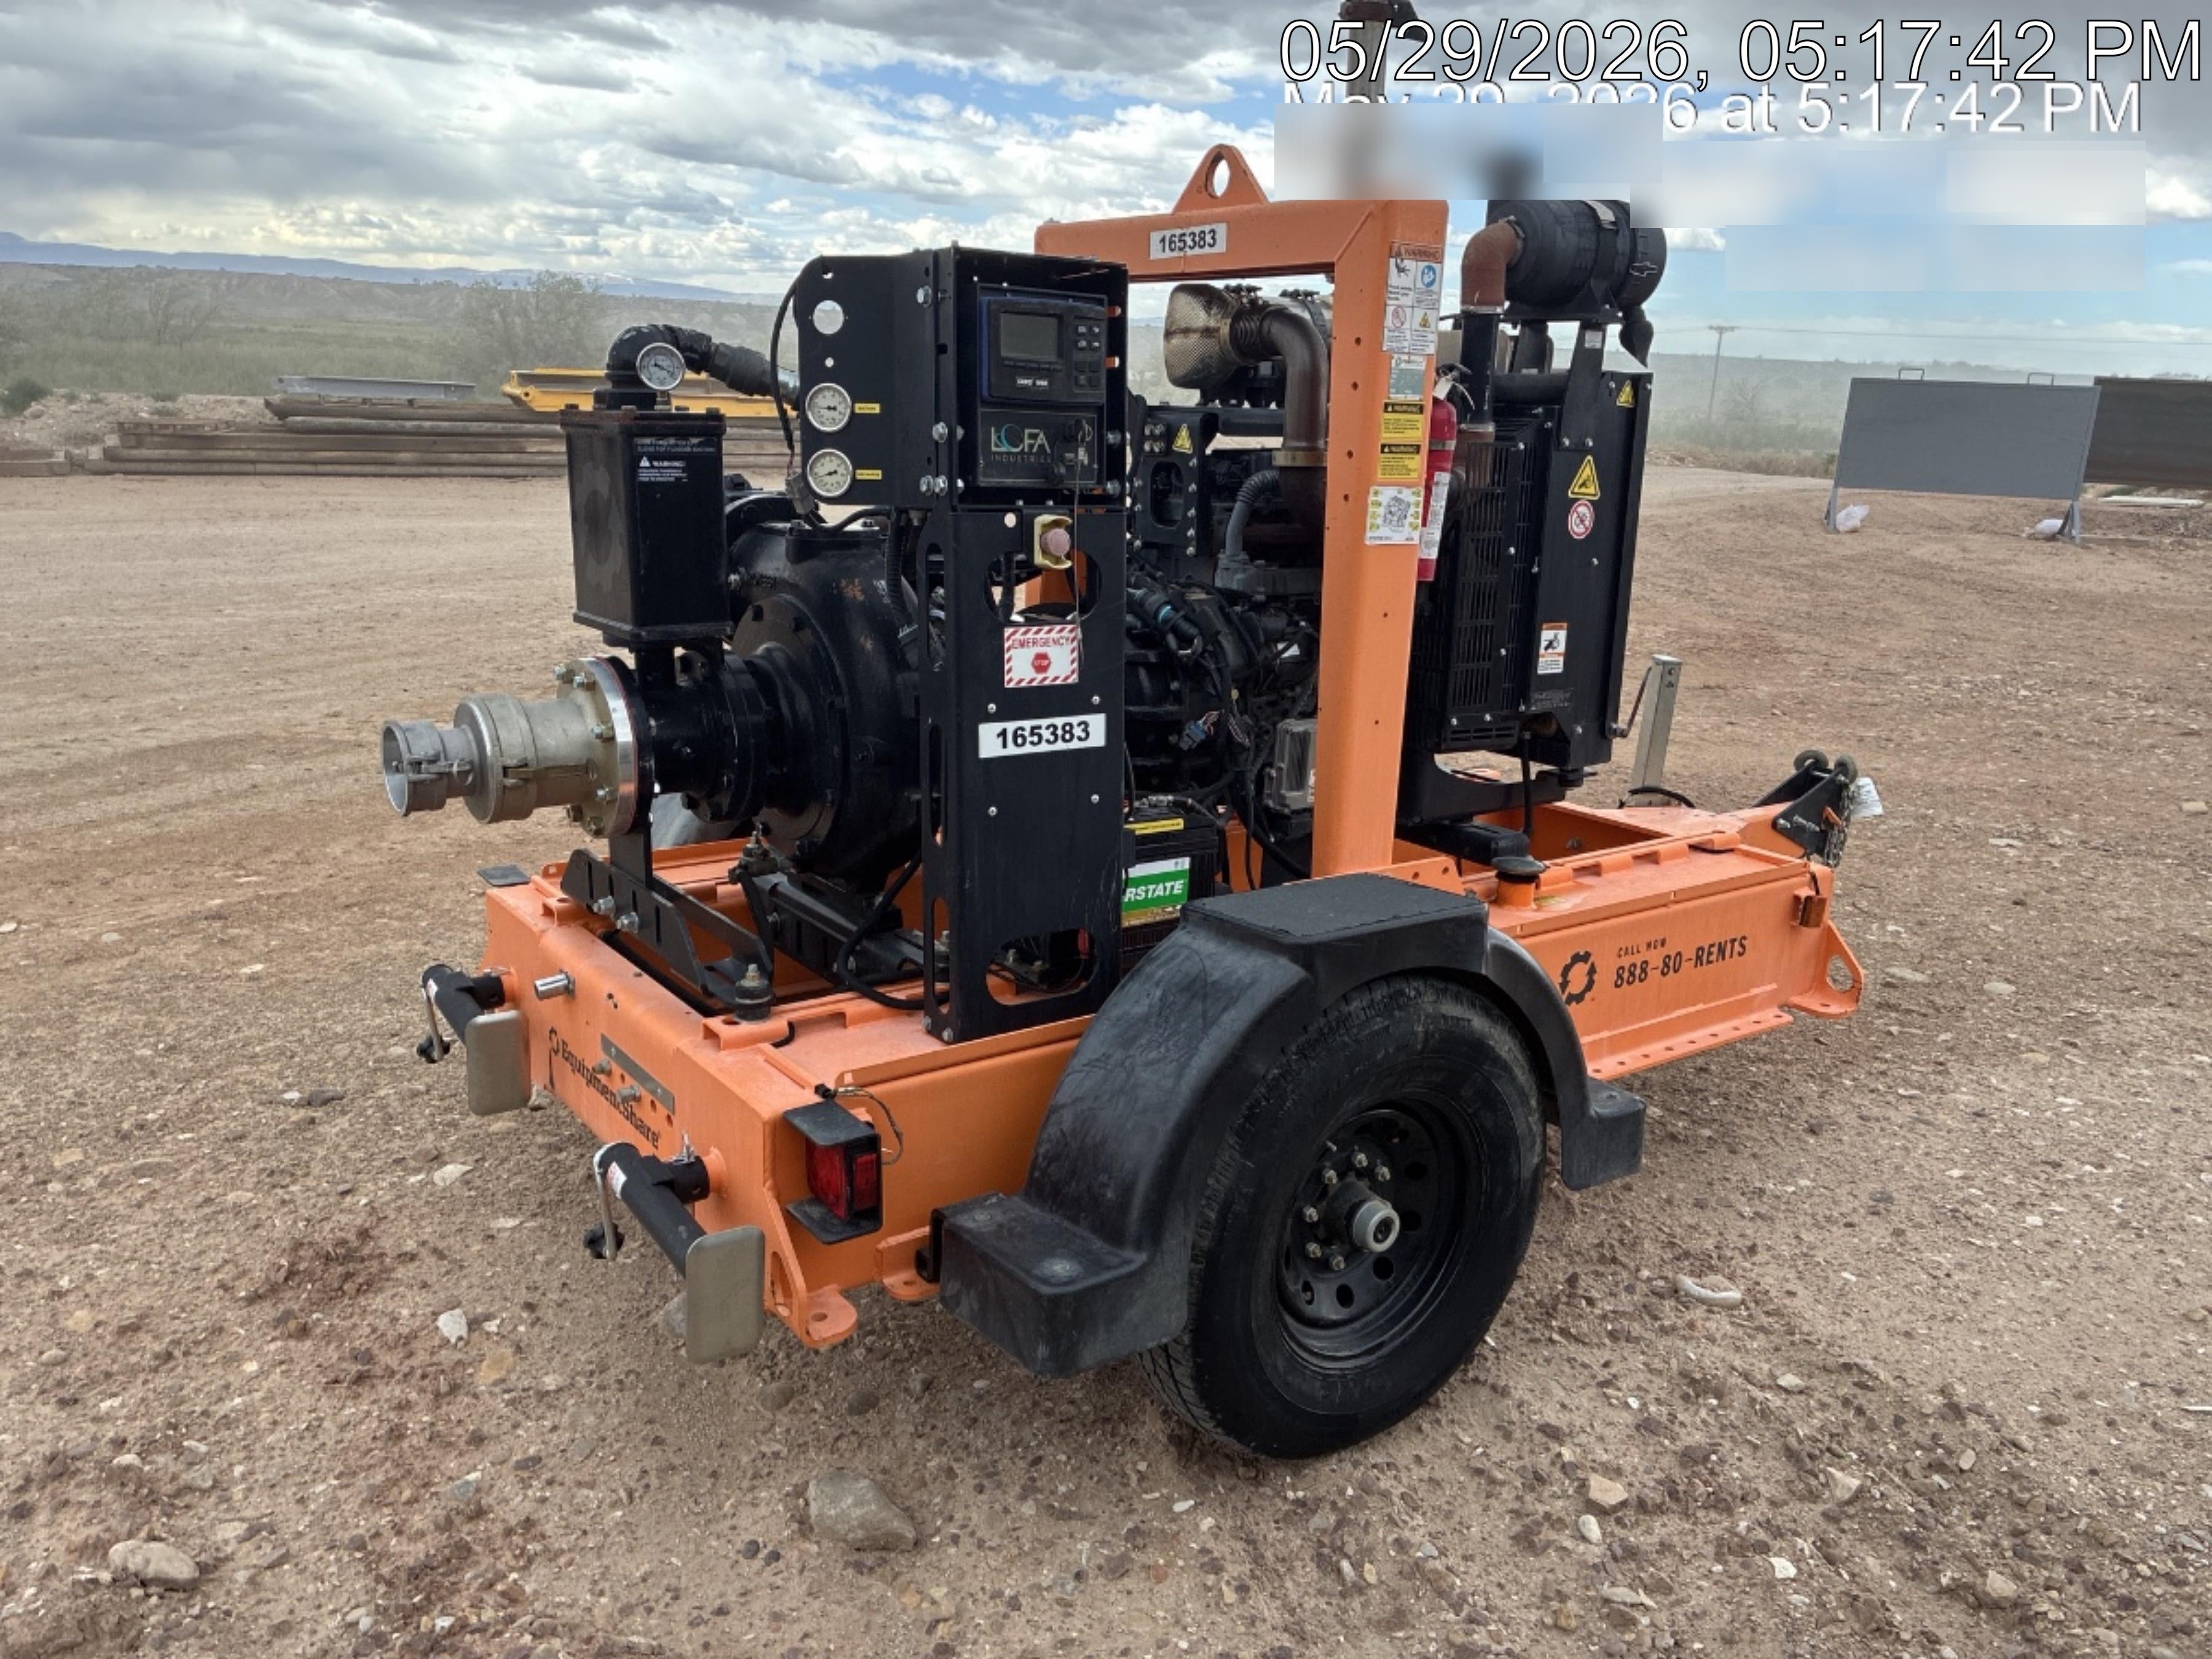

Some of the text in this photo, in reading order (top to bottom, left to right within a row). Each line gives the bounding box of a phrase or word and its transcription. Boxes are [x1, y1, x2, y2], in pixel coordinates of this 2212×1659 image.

[1159, 228, 1217, 253] 165383
[1011, 635, 1072, 649] EMERGENCY
[997, 720, 1090, 750] 165383
[1123, 879, 1184, 902] RSTATE
[1614, 935, 1747, 989] 888-80-RENTS
[1617, 943, 1641, 959] CALL
